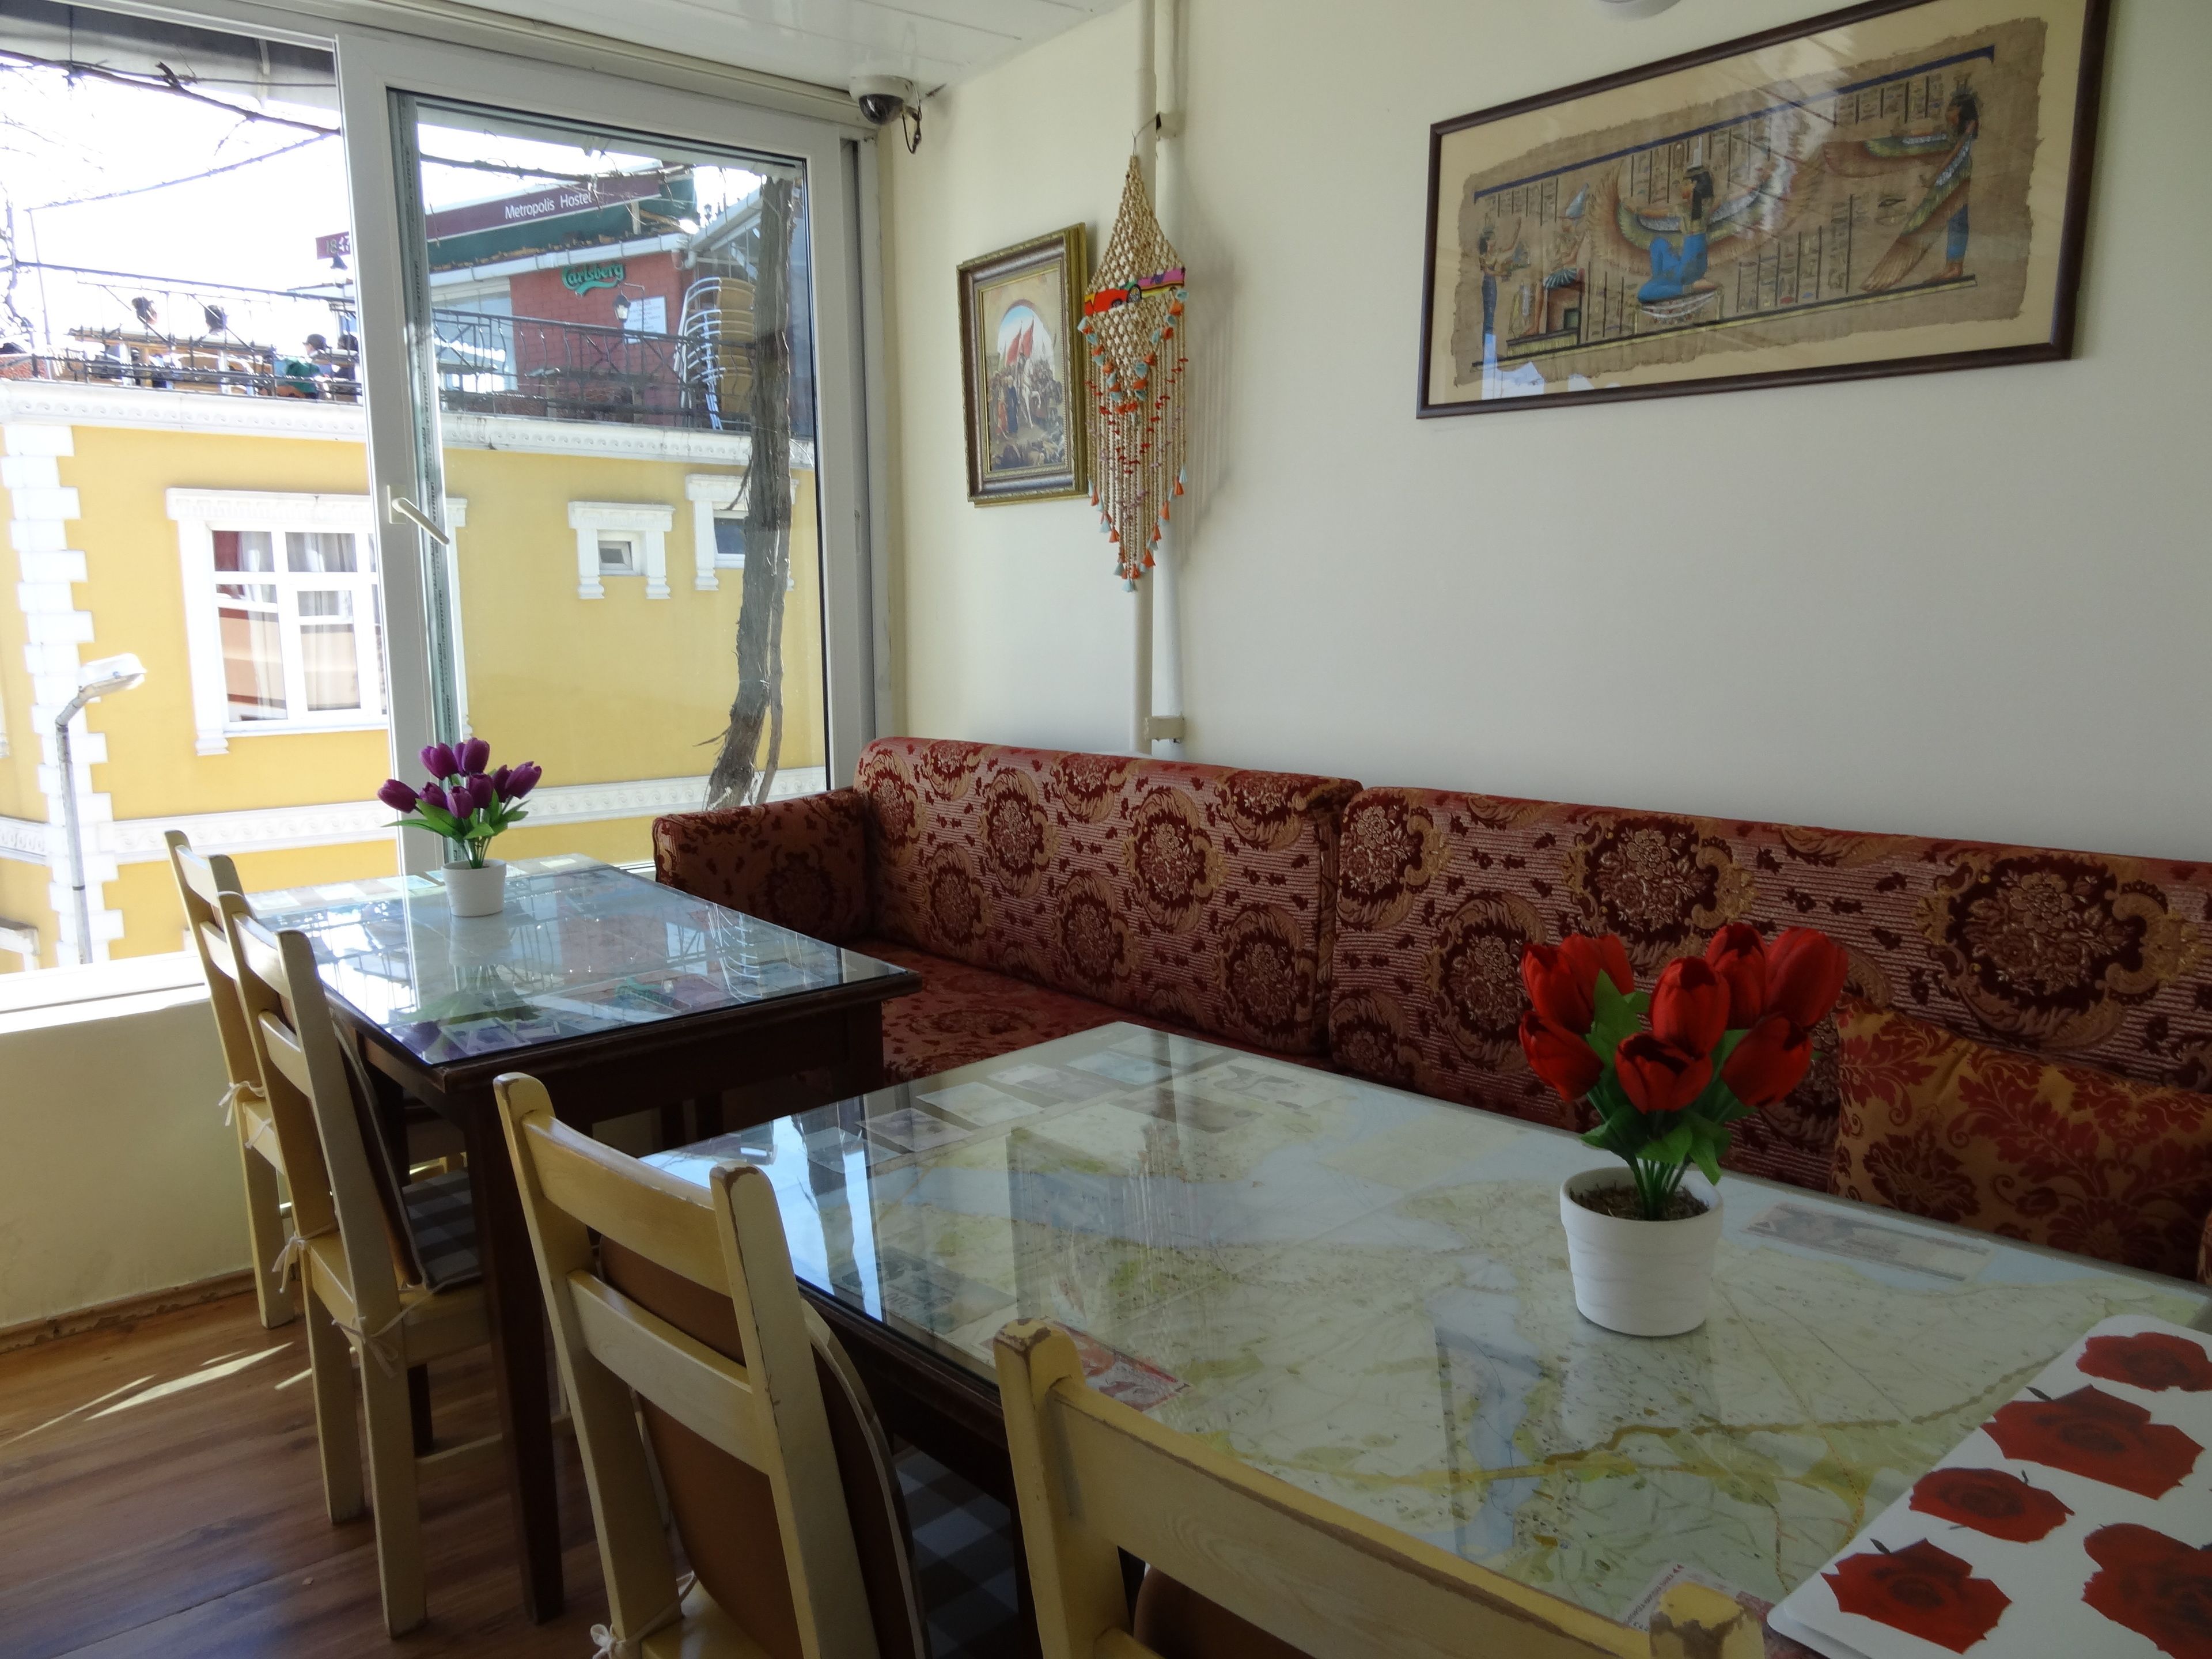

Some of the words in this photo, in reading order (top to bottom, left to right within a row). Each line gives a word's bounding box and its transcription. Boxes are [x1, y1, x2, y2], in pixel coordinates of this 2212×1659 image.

[505, 198, 555, 219] Metropolis
[560, 191, 592, 209] Hostel
[562, 263, 624, 291] Carlsberg
